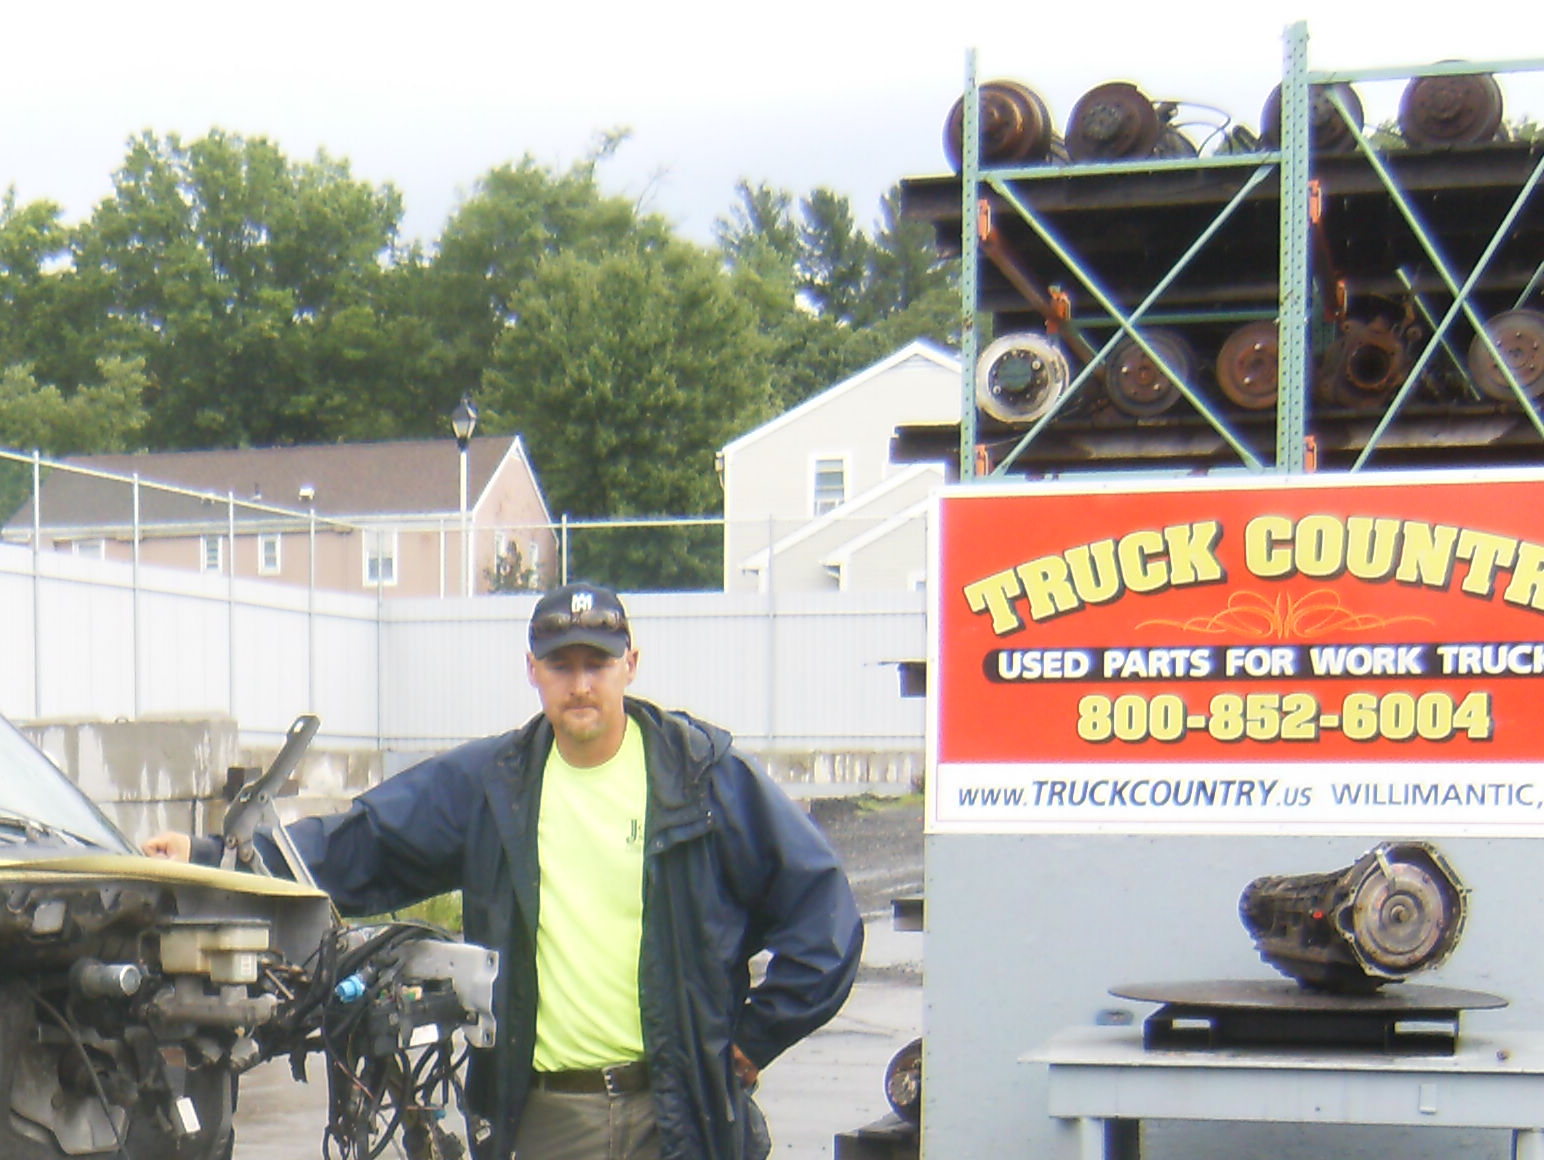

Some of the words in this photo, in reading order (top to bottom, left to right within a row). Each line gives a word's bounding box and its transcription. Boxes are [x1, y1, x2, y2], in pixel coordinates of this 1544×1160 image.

[963, 520, 1223, 637] TRUCK
[997, 649, 1091, 679] USED
[1102, 648, 1212, 678] PARTS
[1225, 646, 1295, 677] FOR
[1309, 645, 1424, 676] WORK
[1077, 692, 1492, 741] 800-852-6004
[1331, 783, 1543, 809] WILLIMANTIC,
